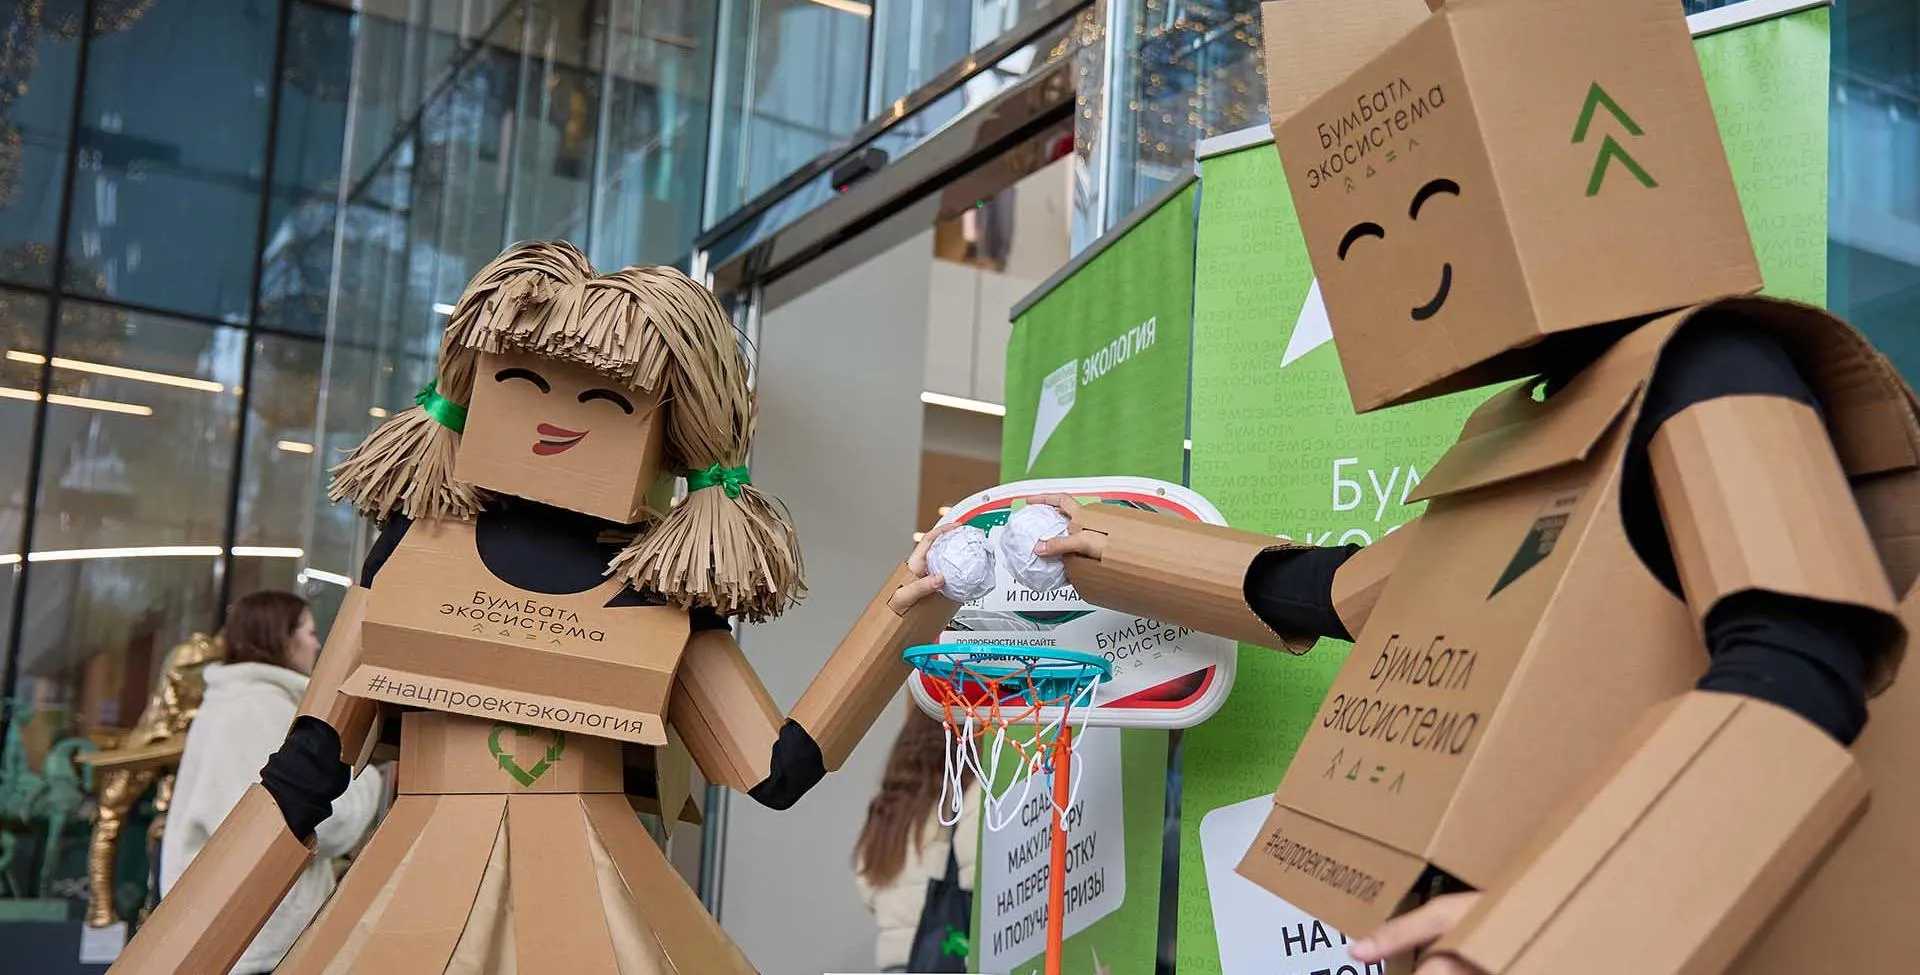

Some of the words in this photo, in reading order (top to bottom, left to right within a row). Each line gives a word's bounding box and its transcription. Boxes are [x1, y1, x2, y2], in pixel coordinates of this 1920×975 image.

[1306, 84, 1446, 189] экосистема
[1316, 77, 1411, 149] БумБатл
[1081, 315, 1157, 386] ЭКОЛОГИЯ
[471, 590, 582, 624] БумБатл
[1007, 590, 1017, 602] И
[1020, 589, 1082, 602] ПОЛУЧА
[439, 602, 607, 643] экосистема
[1017, 639, 1027, 647] НА
[1029, 637, 1056, 647] САЙТЕ
[1095, 618, 1164, 649] БумБа
[1369, 634, 1478, 694] БумБатл
[366, 673, 644, 735] #нацпроектэкология
[1323, 693, 1480, 756] экосистема
[996, 888, 1015, 917] НА
[993, 930, 1003, 957] И
[1005, 903, 1049, 951] ПОЛУЧА
[1281, 919, 1333, 957] НА
